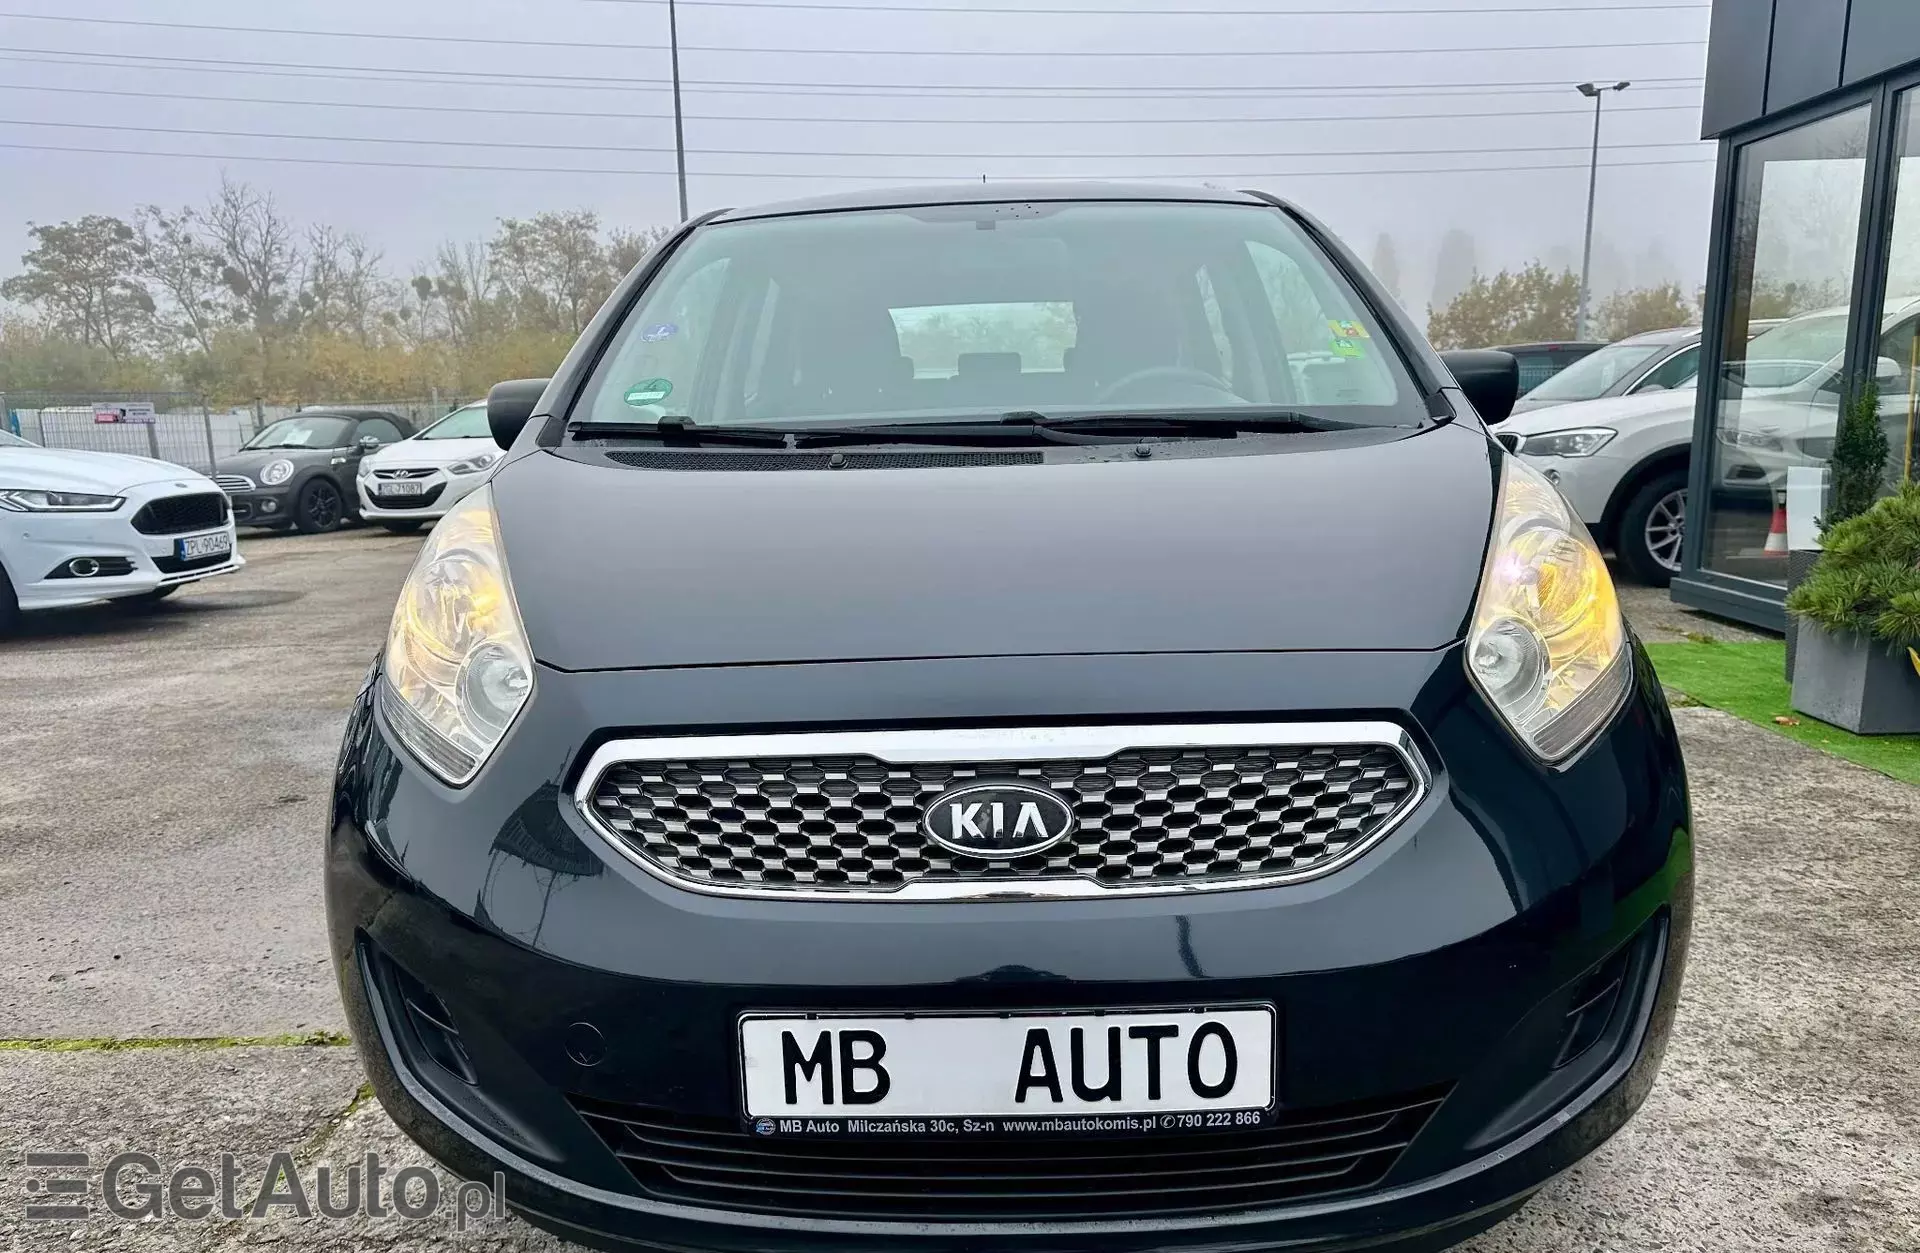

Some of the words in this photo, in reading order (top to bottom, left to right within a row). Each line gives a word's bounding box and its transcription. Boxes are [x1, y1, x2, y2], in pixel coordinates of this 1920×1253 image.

[203, 534, 228, 552] 90469
[949, 802, 1049, 839] KIA
[780, 1028, 892, 1105] MB
[1014, 1021, 1238, 1104] AUTO
[779, 1120, 802, 1133] MB
[806, 1119, 840, 1133] Auto
[848, 1118, 926, 1133] Milczańska
[930, 1119, 959, 1135] 30c,
[963, 1119, 995, 1132] Sz-n
[1002, 1116, 1157, 1132] www.mbautokomis.pl
[1177, 1114, 1202, 1128] 790
[1206, 1112, 1232, 1127] 222
[1235, 1111, 1261, 1125] 866
